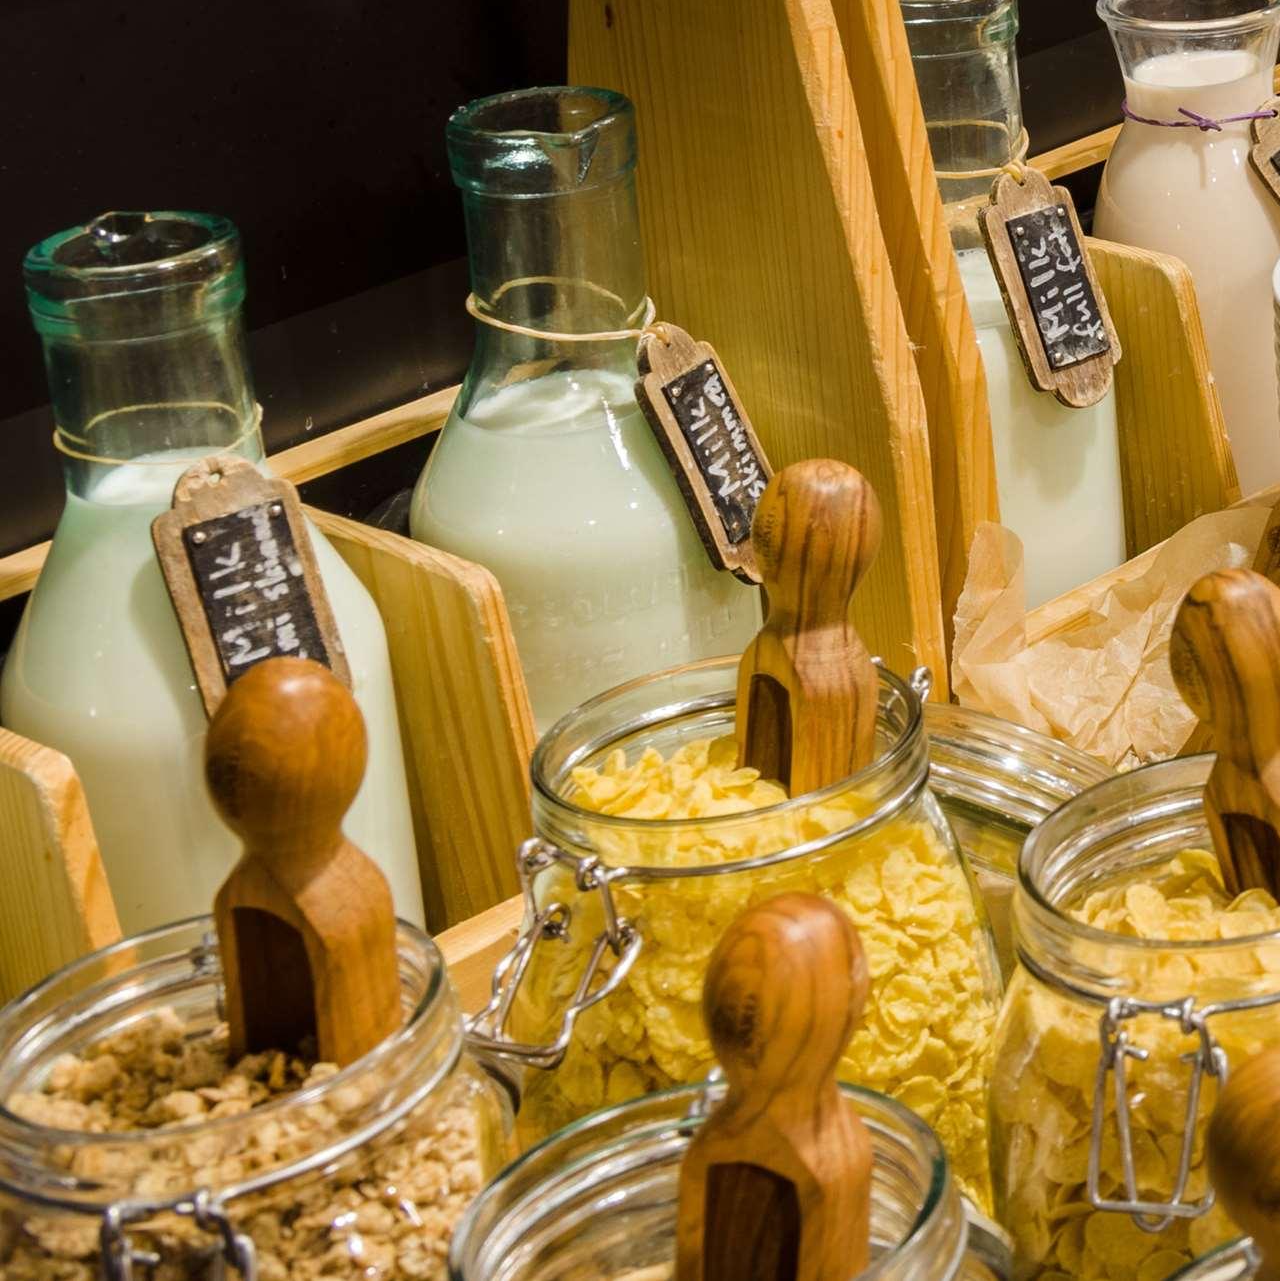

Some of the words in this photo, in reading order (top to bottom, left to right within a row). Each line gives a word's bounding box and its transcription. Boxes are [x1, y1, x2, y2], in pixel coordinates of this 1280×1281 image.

[1027, 236, 1071, 344] Milk
[689, 395, 742, 499] Milk
[208, 541, 273, 666] Milk
